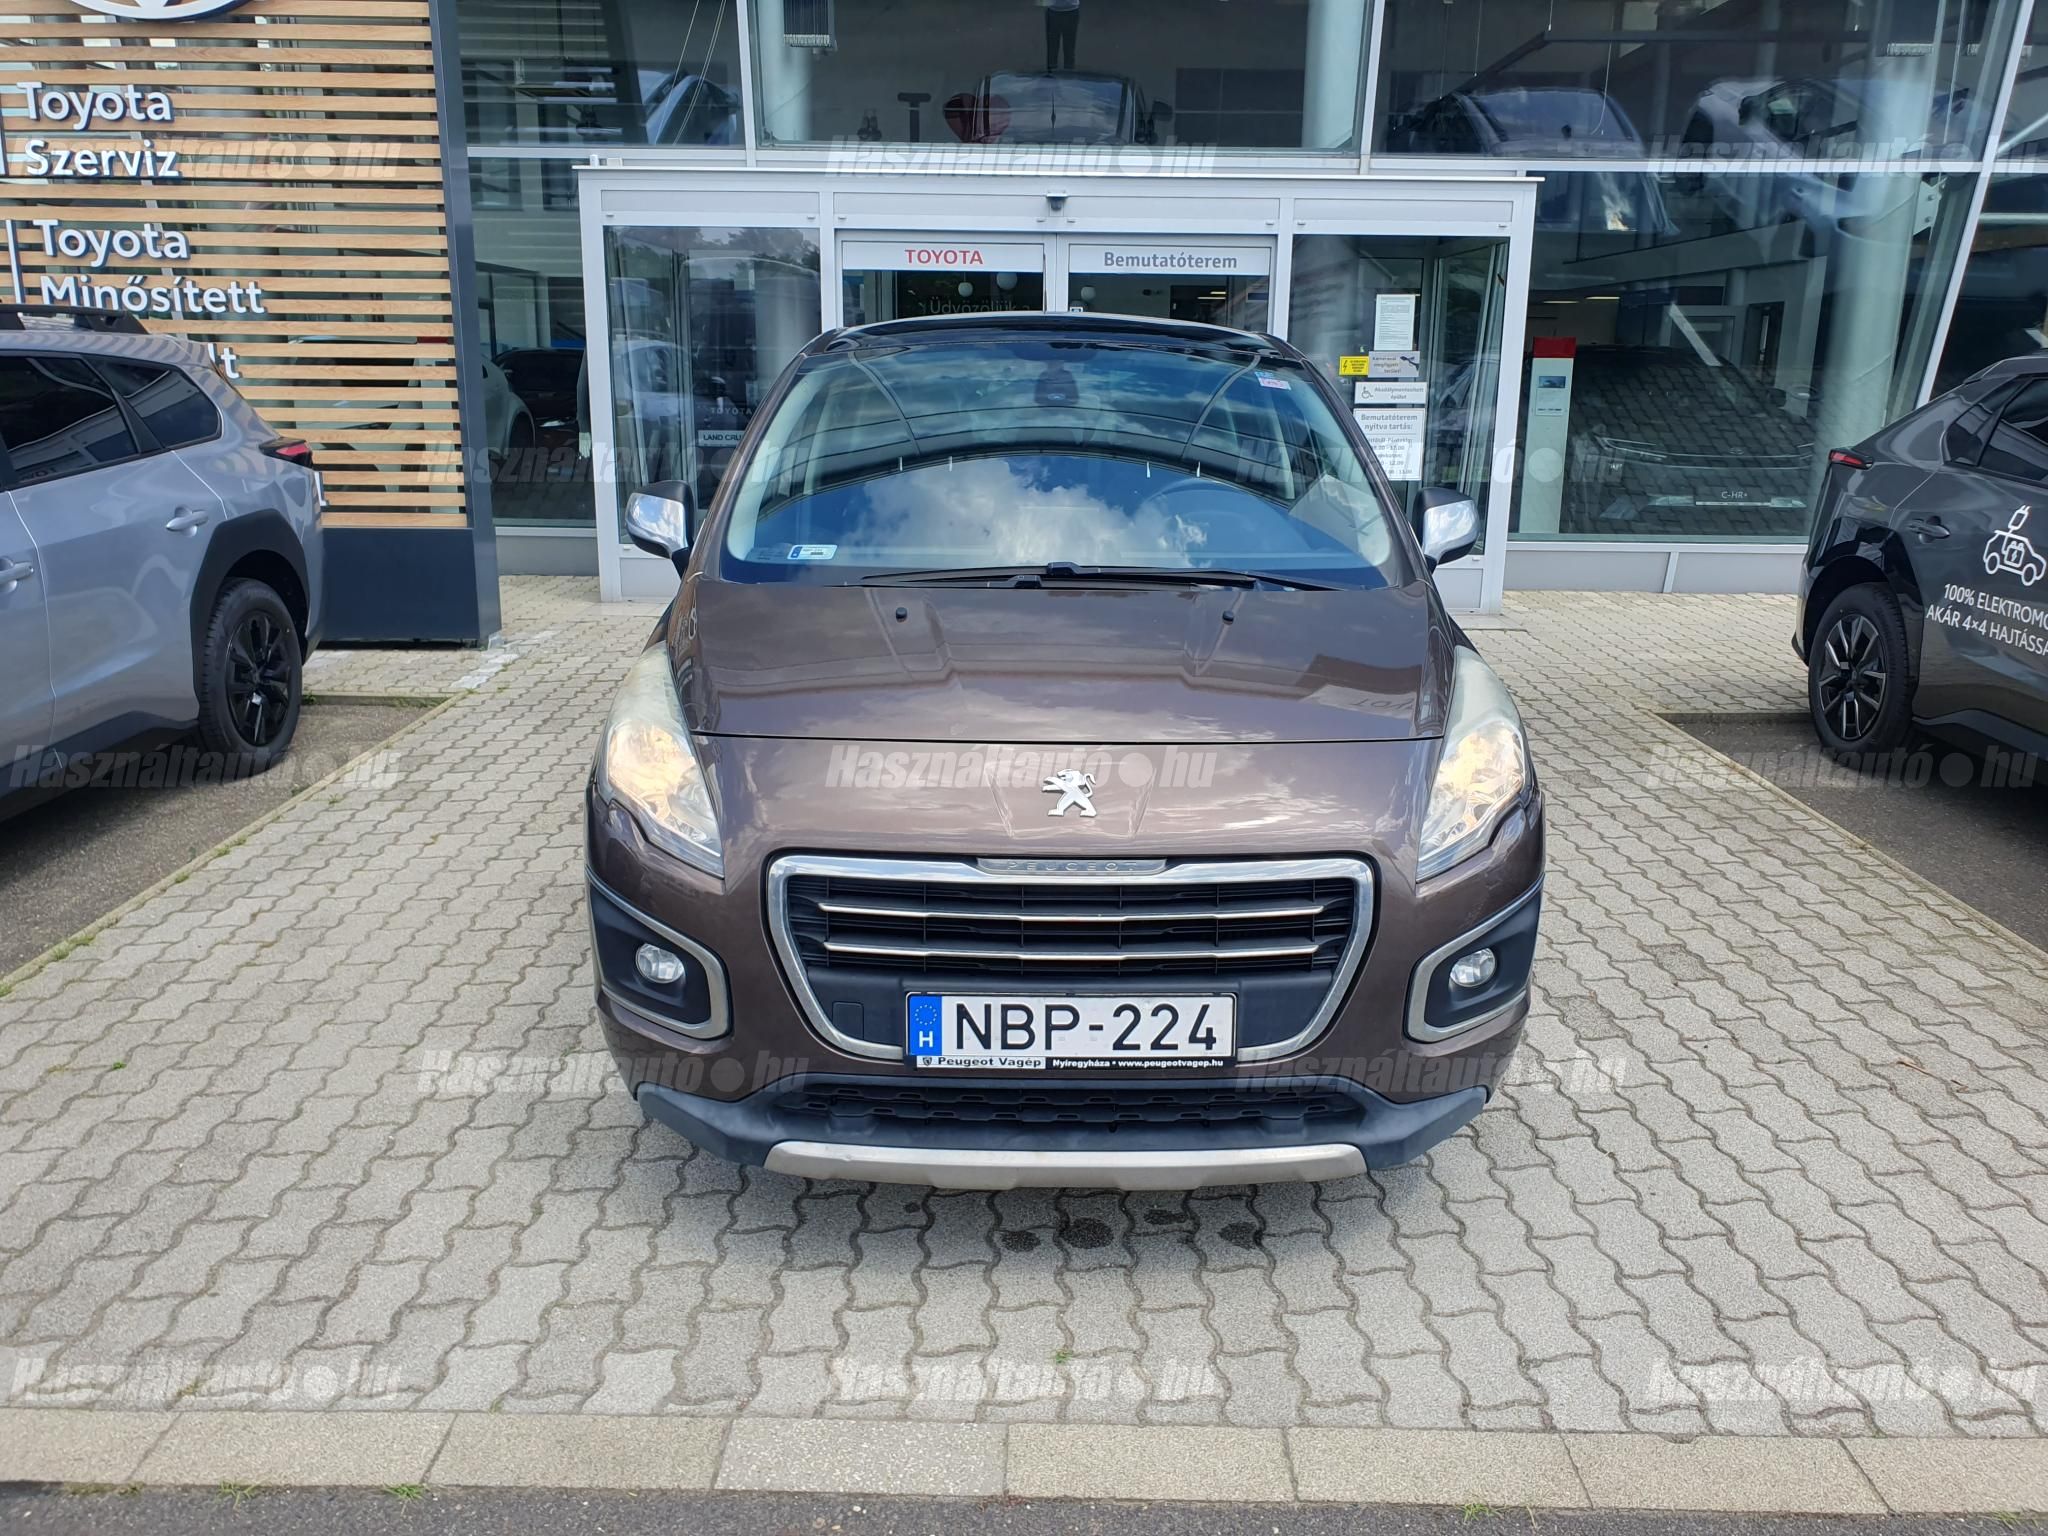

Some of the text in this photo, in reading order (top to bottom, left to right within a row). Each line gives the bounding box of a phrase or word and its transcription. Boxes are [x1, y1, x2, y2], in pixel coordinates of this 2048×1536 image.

[17, 82, 172, 130] Toyota
[25, 139, 180, 177] Szerviz
[33, 219, 190, 268] Toyota
[905, 249, 983, 265] TOYOTA
[1104, 251, 1237, 269] Bemutatóterem
[40, 275, 265, 314] Minősített
[710, 407, 752, 415] TOYOTA
[1361, 413, 1418, 421] Bemutatóterem
[1364, 422, 1413, 431] nyitva tartás:
[1944, 583, 1976, 606] 100%
[1926, 604, 1961, 628] AKÁR
[955, 1003, 1217, 1051] NBP-224
[918, 1031, 934, 1048] H
[937, 1057, 1041, 1068] Peugeot Vagép
[1052, 1059, 1110, 1069] Nyíregyháza
